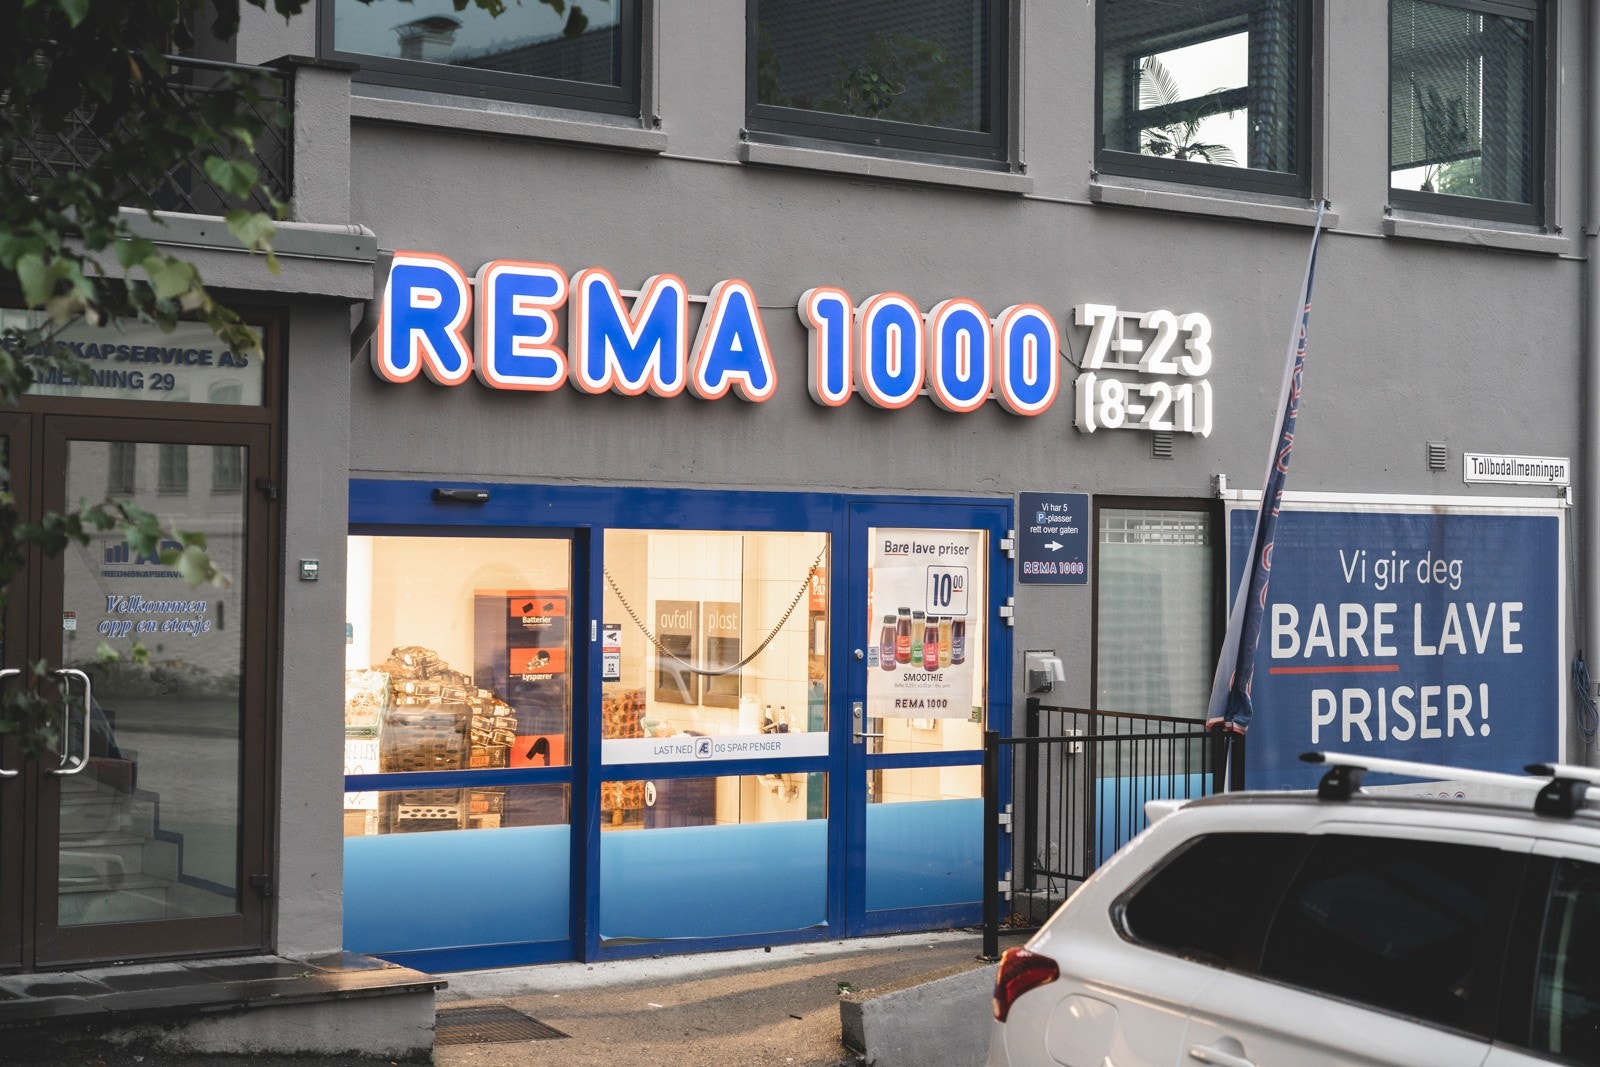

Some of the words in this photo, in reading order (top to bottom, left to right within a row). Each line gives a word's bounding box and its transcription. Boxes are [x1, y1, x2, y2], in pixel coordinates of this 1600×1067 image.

[371, 249, 778, 403] REMA
[799, 286, 1060, 417] 1000
[1075, 303, 1212, 376] 7-23
[150, 373, 176, 391] 29
[1076, 372, 1213, 438] (8-21)
[1472, 457, 1565, 481] Tollbodallmenningen
[1042, 503, 1049, 511] Vi
[1050, 503, 1061, 511] har
[1063, 503, 1068, 511] 5
[1060, 526, 1079, 535] gaten
[884, 540, 910, 553] Bare
[912, 541, 936, 554] lave
[938, 542, 970, 556] priser
[1023, 561, 1057, 575] REMA
[1059, 561, 1084, 575] 1000
[1339, 549, 1366, 583] Vi
[1374, 550, 1410, 590] gir
[1416, 550, 1463, 590] deg
[933, 573, 952, 607] 10
[106, 595, 207, 614] Velkommen
[99, 619, 133, 638] opp
[136, 619, 157, 633] en
[161, 615, 212, 636] etasje
[522, 616, 552, 624] Batterier
[660, 610, 693, 630] avfall
[708, 611, 738, 633] plast
[1270, 603, 1398, 659] BARE
[1413, 602, 1524, 656] LAVE
[522, 673, 553, 681] Lyspærer
[903, 673, 944, 682] SMOOTHIE
[895, 699, 925, 708] REMA
[927, 699, 948, 708] 1000
[1311, 683, 1491, 744] PRISER!
[654, 746, 673, 755] LAST
[676, 745, 693, 754] NED
[715, 744, 726, 753] OG
[728, 743, 748, 752] SPAR
[750, 741, 781, 751] PENGER
